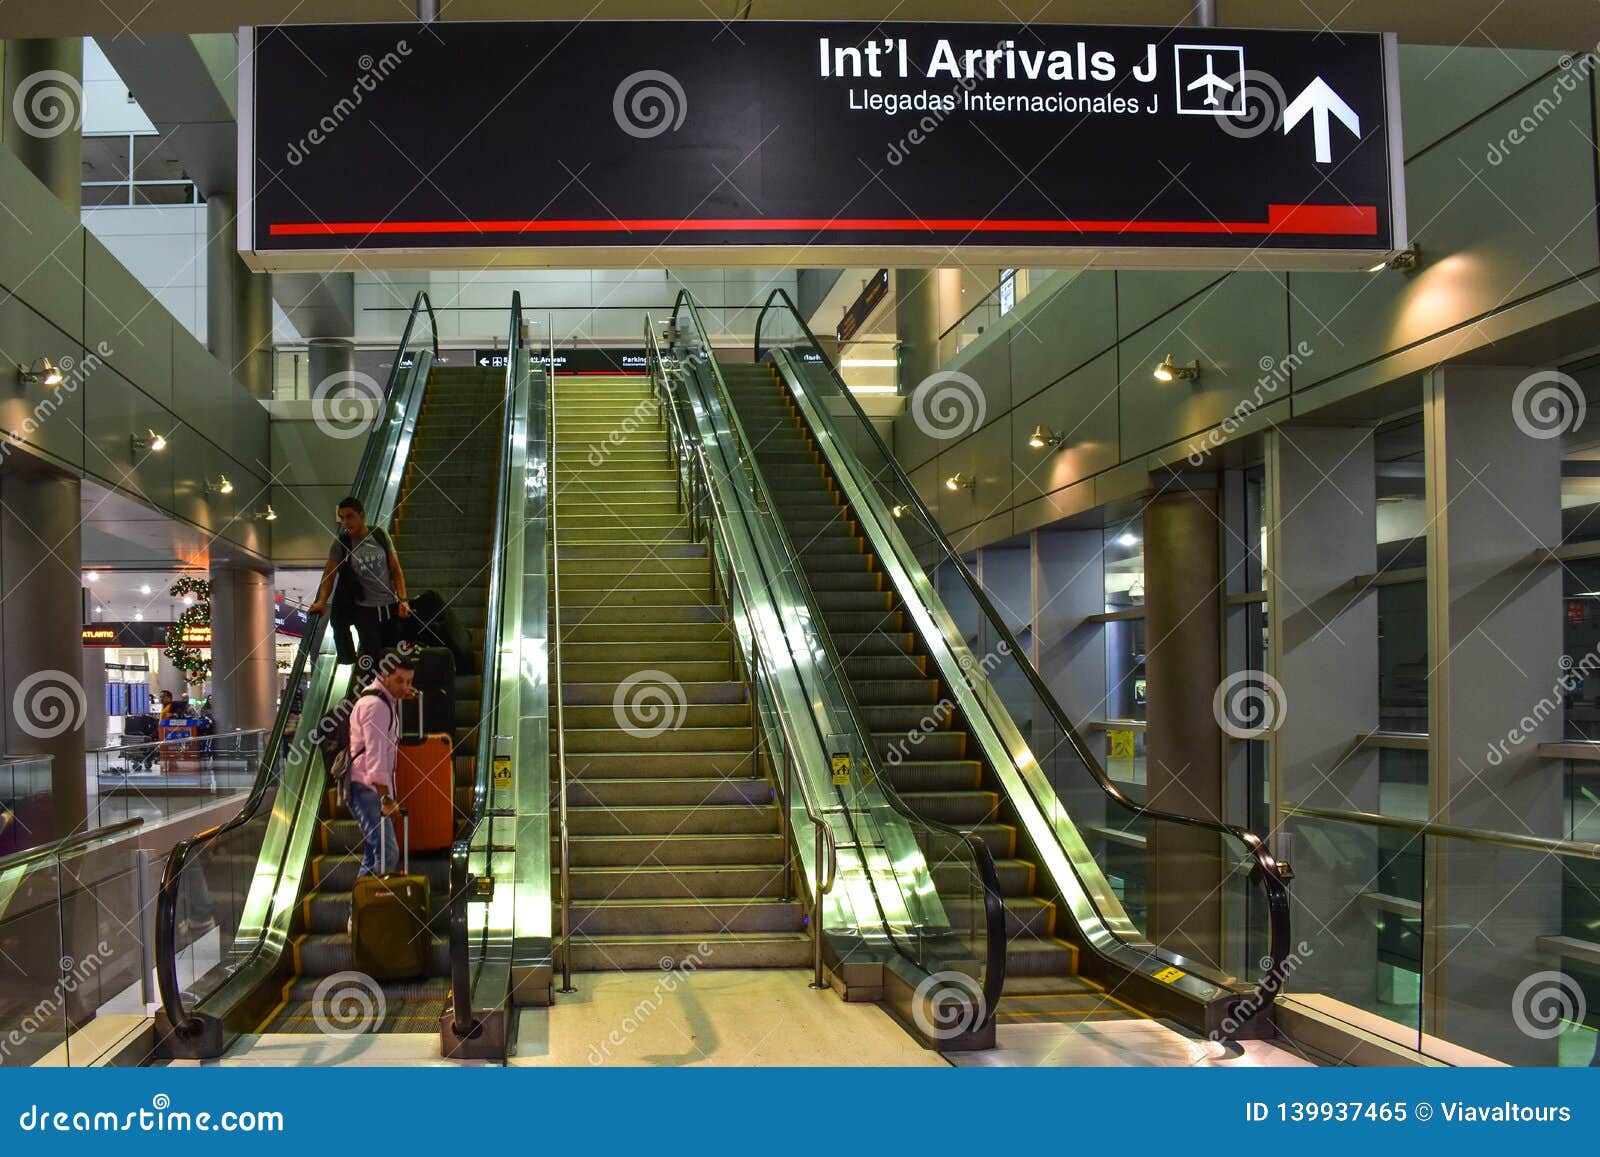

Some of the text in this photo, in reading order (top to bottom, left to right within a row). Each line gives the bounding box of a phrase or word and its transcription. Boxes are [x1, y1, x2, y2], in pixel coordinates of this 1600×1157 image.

[819, 38, 1158, 82] Int'l Arrivals J
[849, 88, 1159, 116] Llegadas Internacionales J
[82, 630, 114, 638] ATLANTIC
